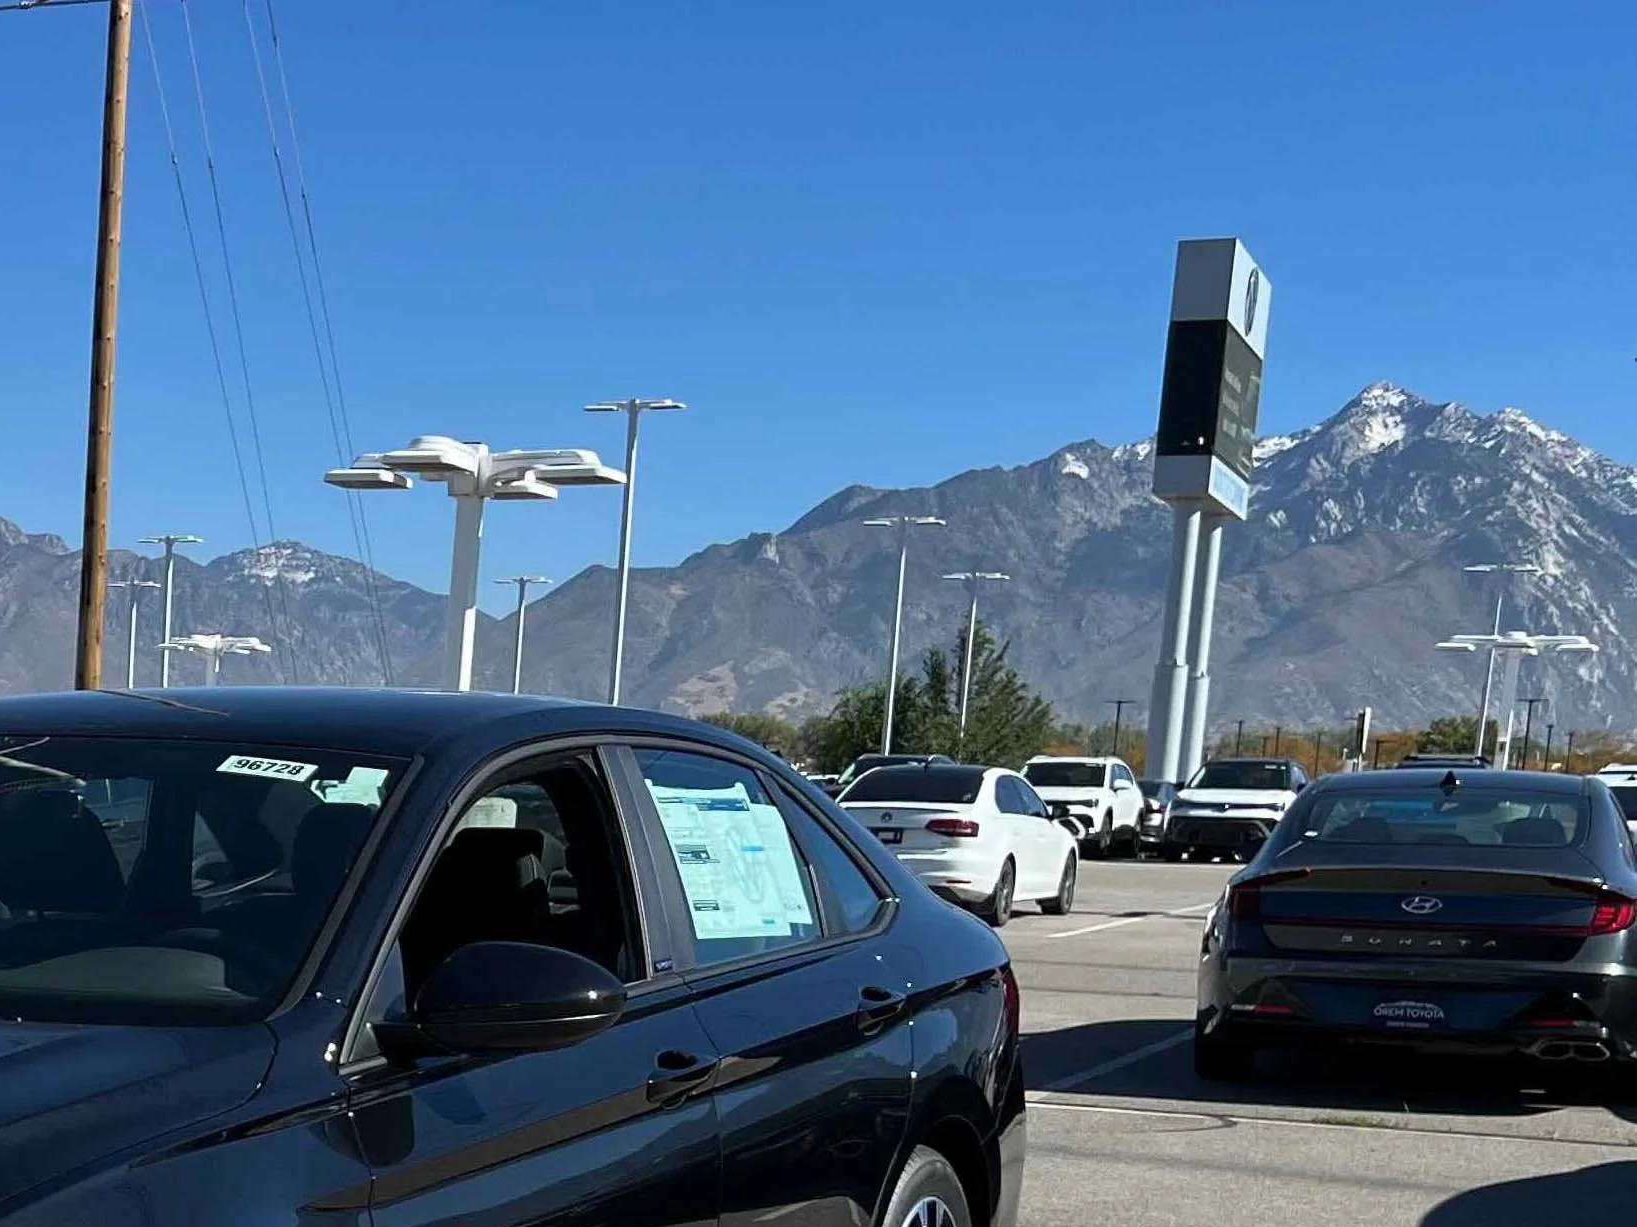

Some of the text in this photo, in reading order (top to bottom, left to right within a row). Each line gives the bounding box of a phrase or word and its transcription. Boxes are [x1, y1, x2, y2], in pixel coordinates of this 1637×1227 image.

[234, 758, 305, 776] 96728
[1341, 935, 1497, 948] SONATA
[1373, 1007, 1445, 1019] OREM TOYOTA
